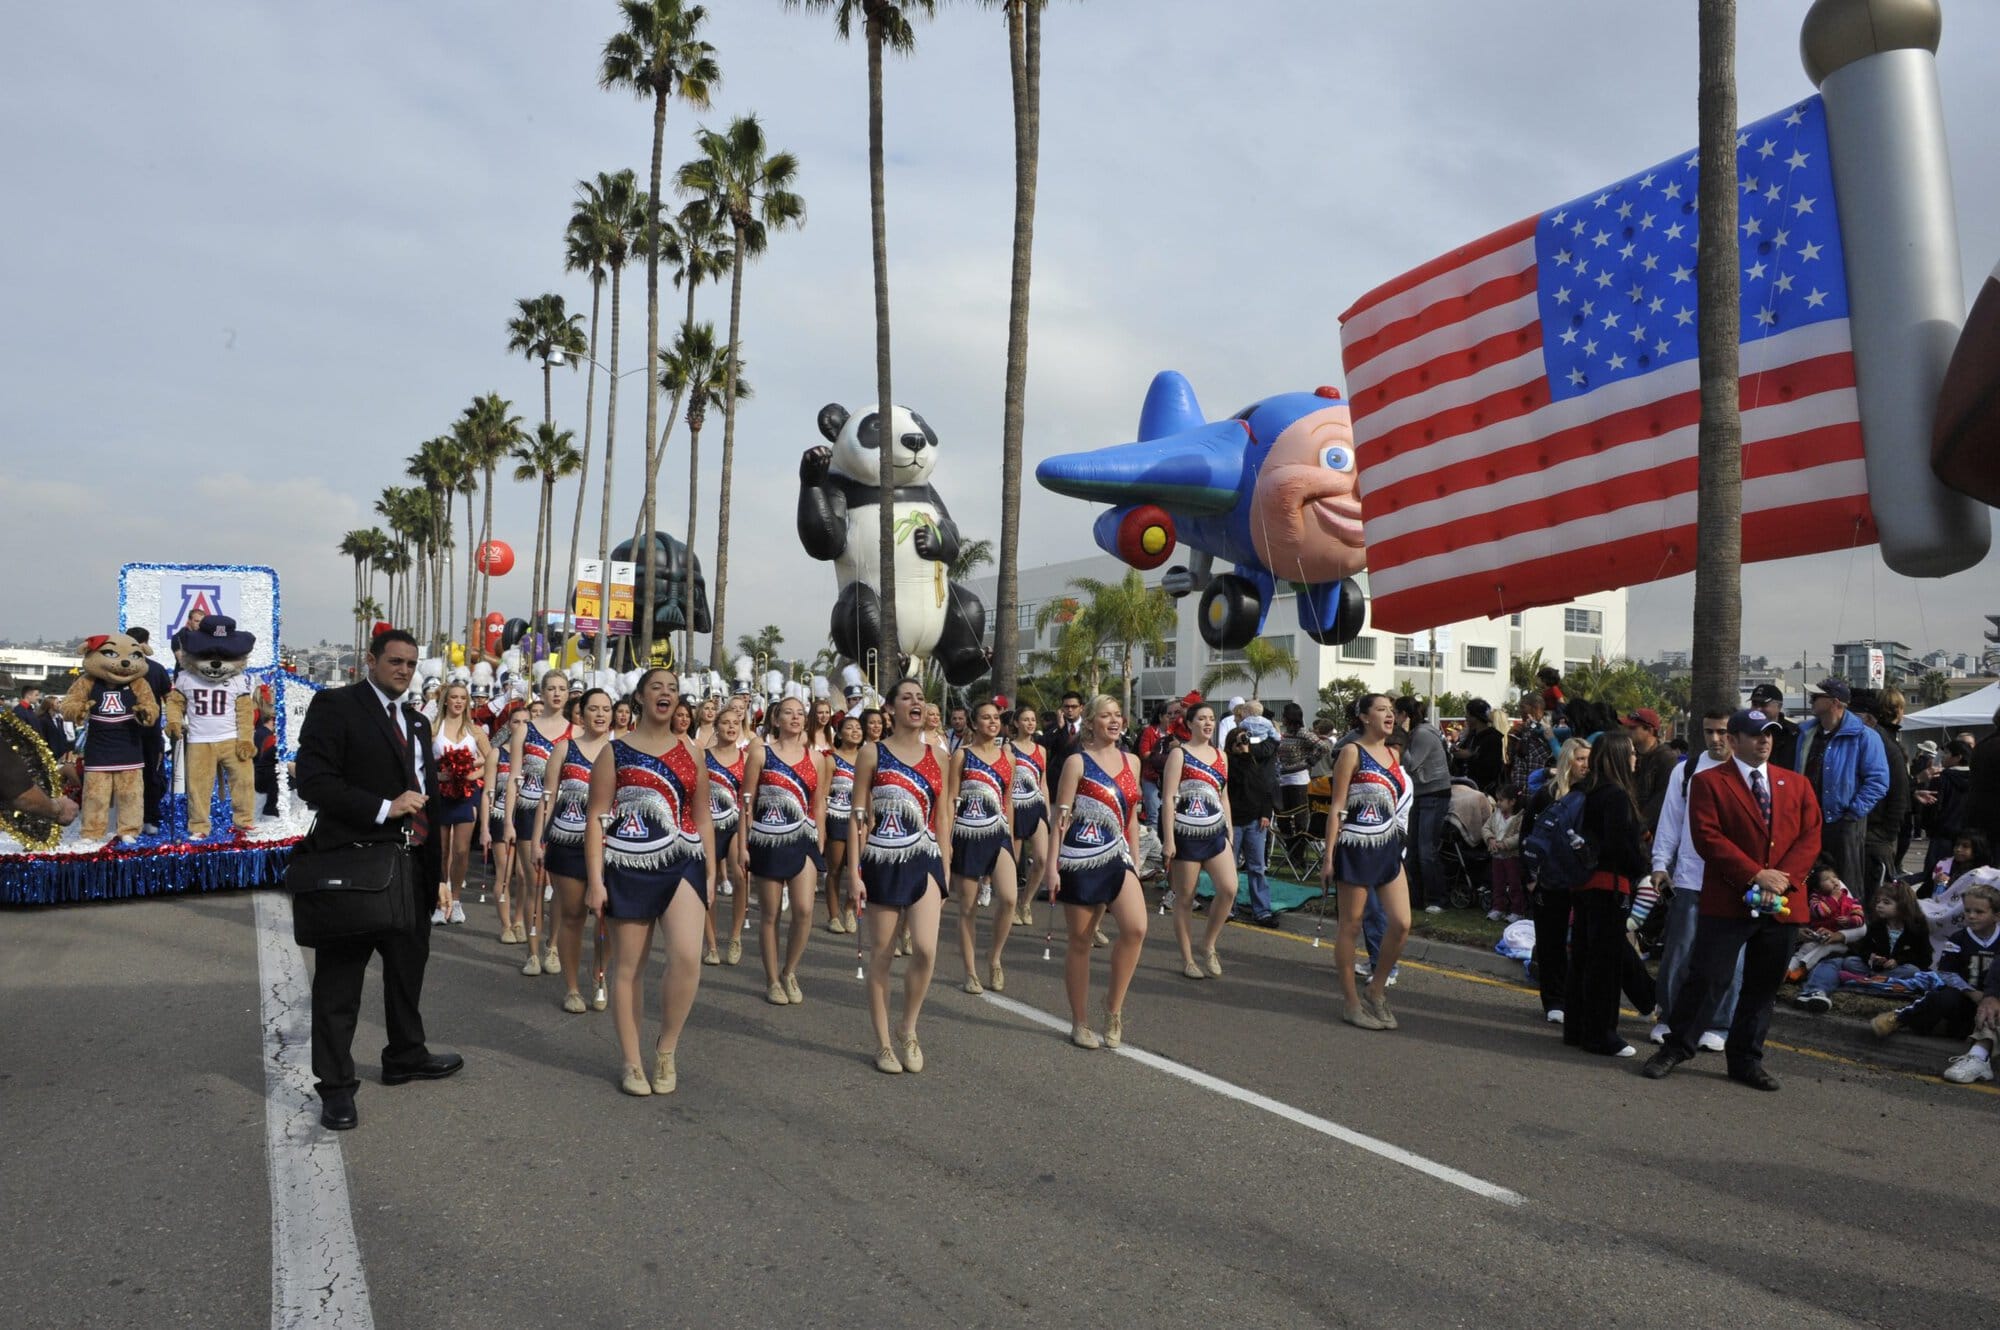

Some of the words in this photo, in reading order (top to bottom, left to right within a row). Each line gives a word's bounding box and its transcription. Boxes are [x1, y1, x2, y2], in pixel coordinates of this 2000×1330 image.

[99, 691, 125, 714] A
[193, 689, 227, 716] 50
[521, 774, 544, 793] A
[831, 790, 850, 806] A
[963, 795, 987, 819] A
[1188, 796, 1209, 817] A
[561, 799, 586, 824] A
[616, 808, 649, 839] A
[761, 803, 787, 825] A
[877, 807, 907, 838] A
[1357, 801, 1383, 825] A
[1076, 818, 1104, 845] A
